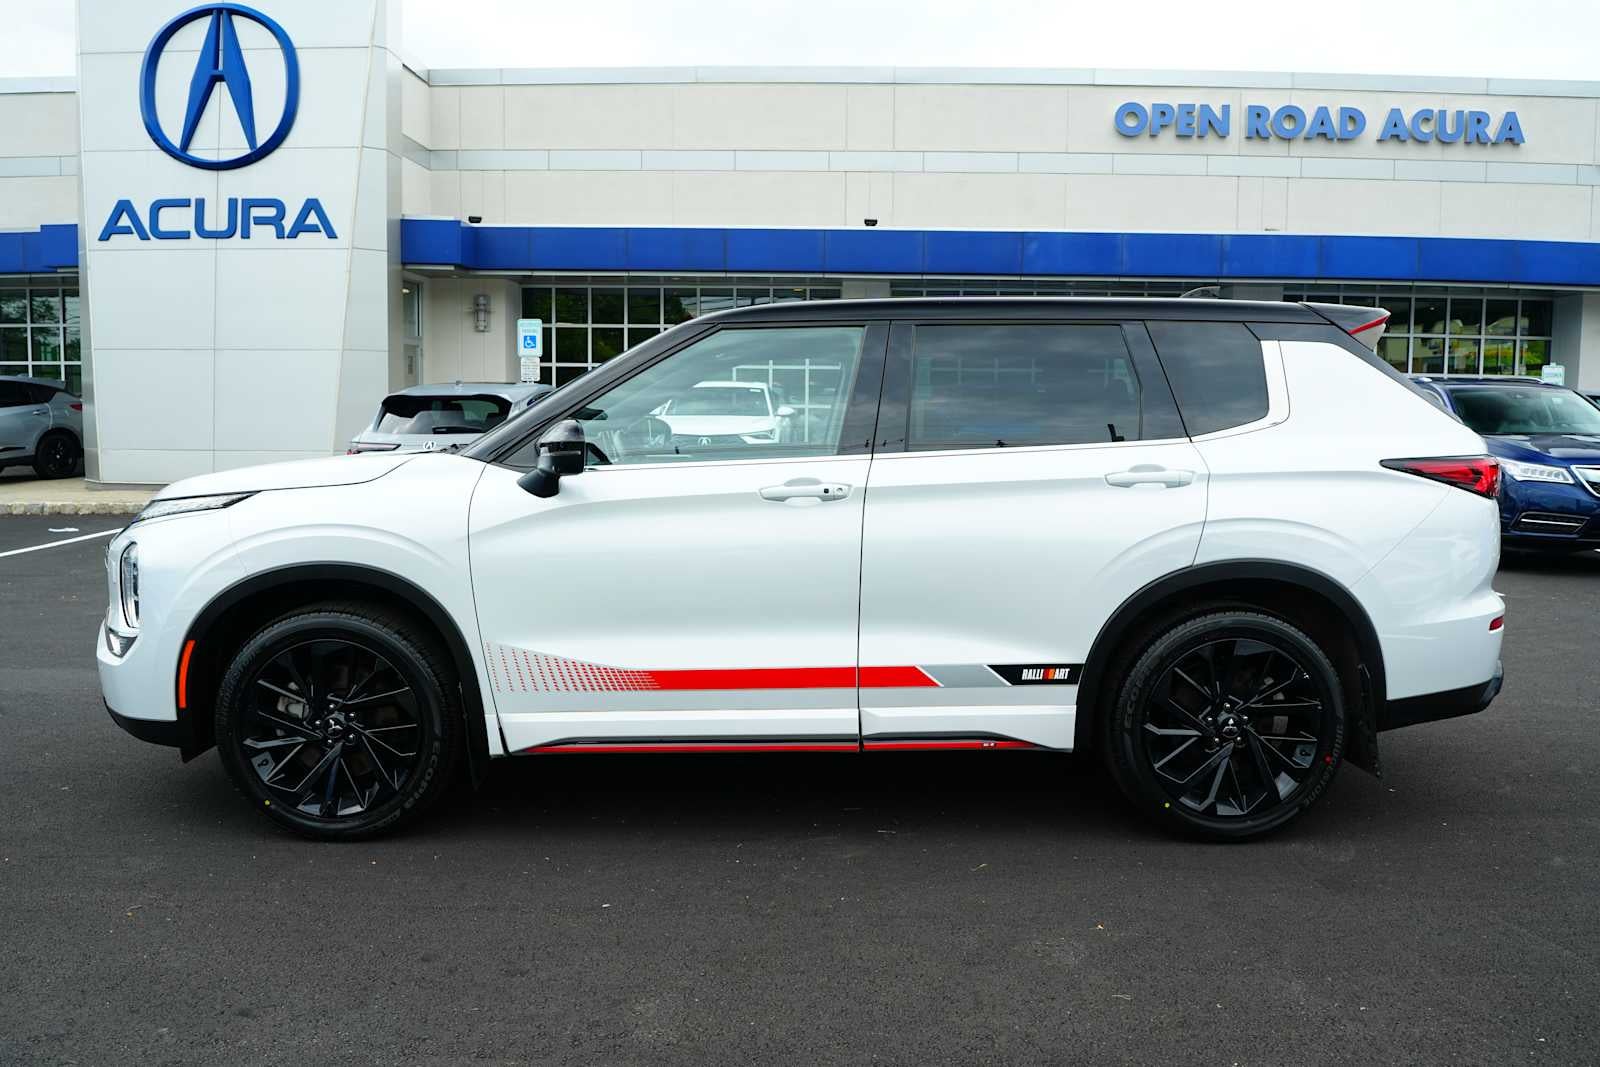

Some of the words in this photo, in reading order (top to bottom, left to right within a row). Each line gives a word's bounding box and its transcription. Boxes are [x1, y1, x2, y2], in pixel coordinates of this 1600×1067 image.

[1114, 101, 1231, 138] OPEN
[1245, 104, 1367, 140] ROAD
[1376, 107, 1526, 145] ACURA
[97, 197, 339, 242] ACURA
